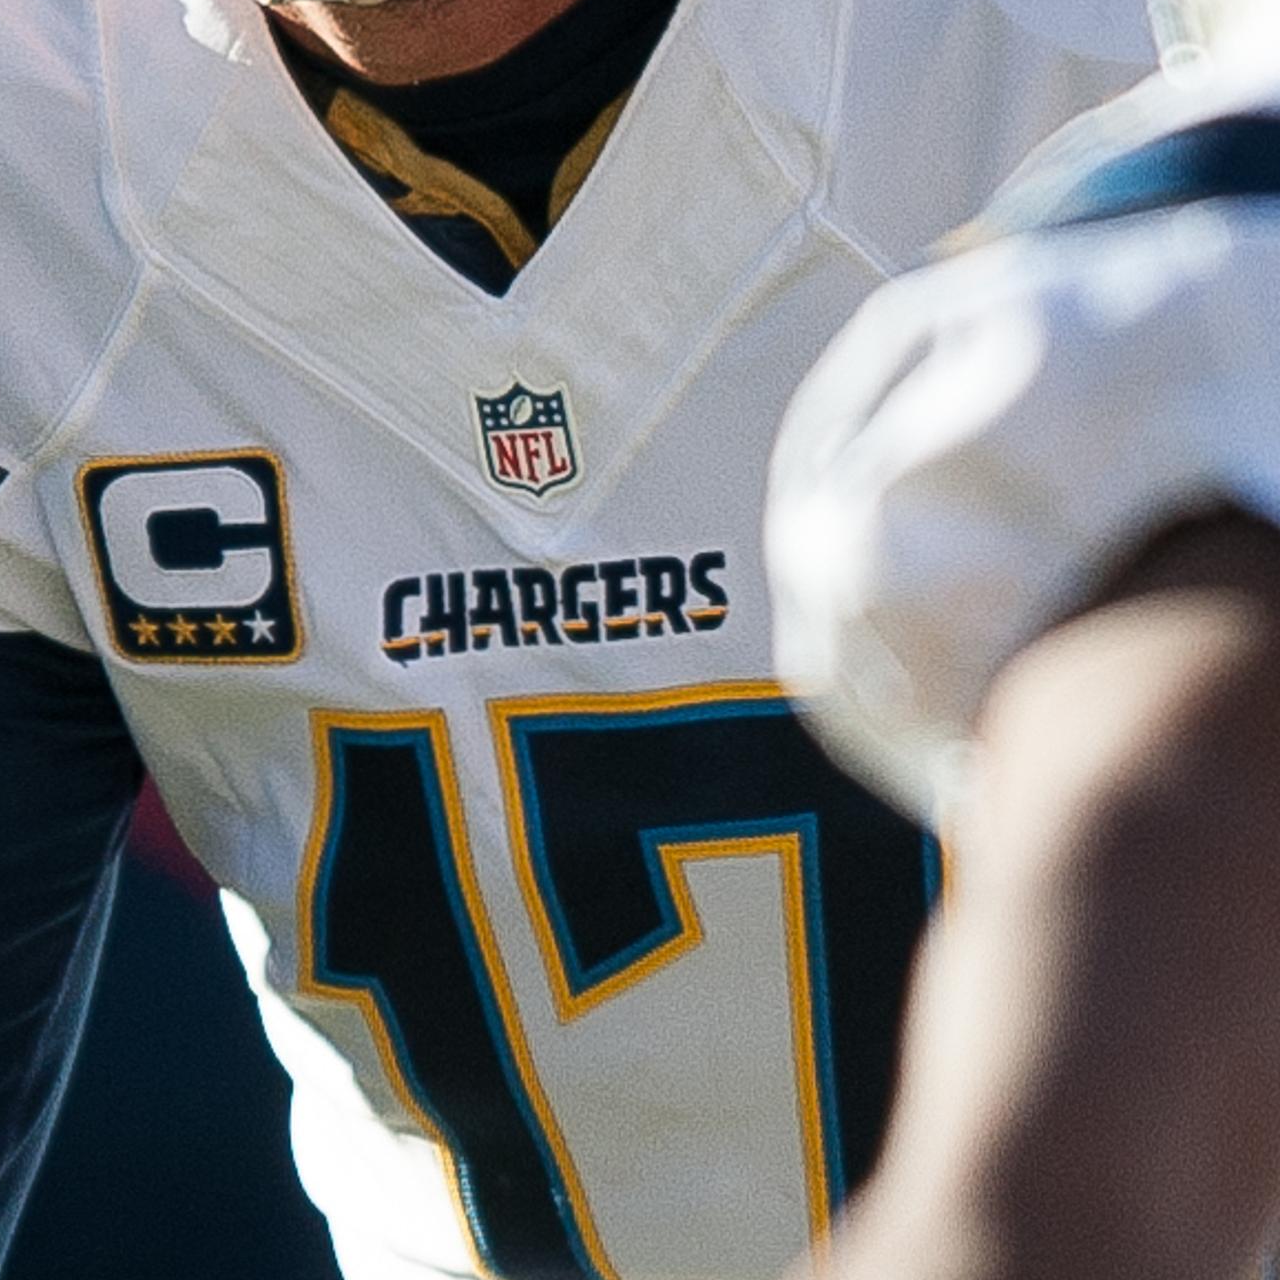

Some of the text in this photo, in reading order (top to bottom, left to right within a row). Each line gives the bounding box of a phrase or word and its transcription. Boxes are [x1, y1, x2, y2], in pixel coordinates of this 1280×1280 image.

[491, 430, 569, 482] NFL
[99, 464, 274, 611] C
[380, 549, 729, 665] CHARGERS
